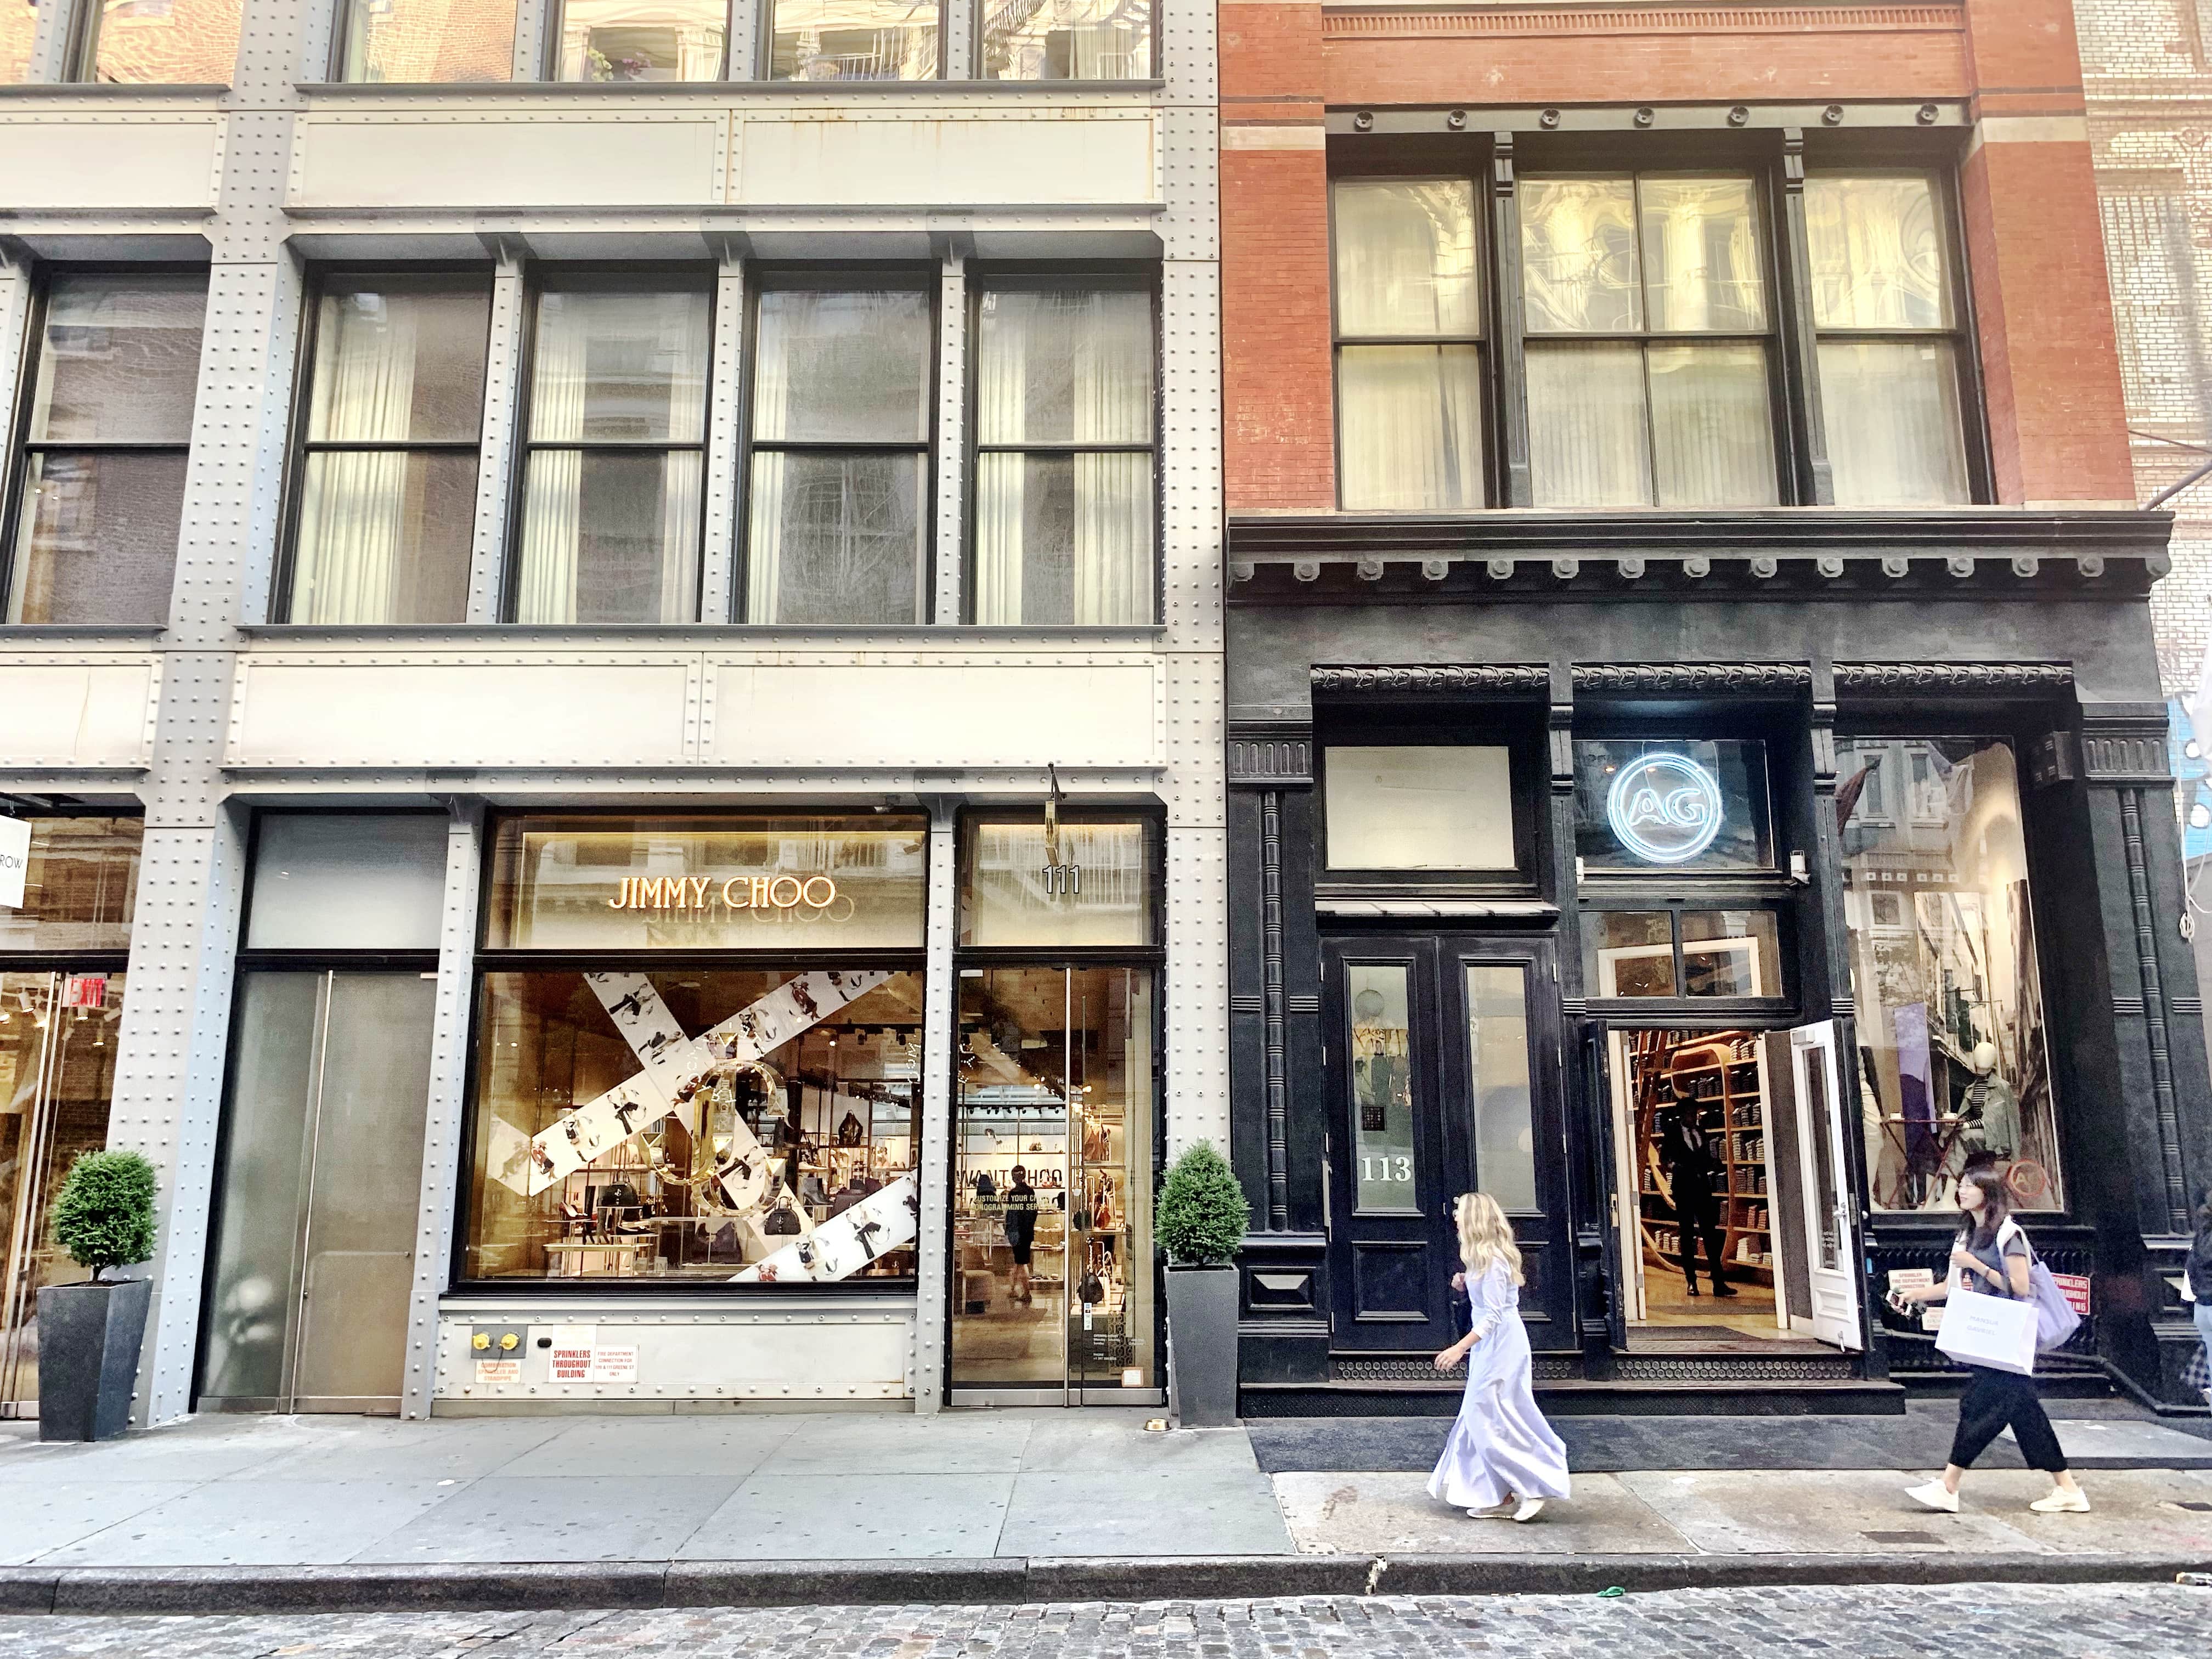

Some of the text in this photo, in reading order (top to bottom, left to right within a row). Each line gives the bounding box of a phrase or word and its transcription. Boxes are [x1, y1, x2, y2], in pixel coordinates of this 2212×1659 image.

[1627, 788, 1707, 827] AG
[1043, 864, 1080, 894] 111
[607, 876, 837, 909] JIMMY CHOO
[1361, 1155, 1412, 1182] 113
[1028, 1169, 1063, 1187] HOO
[2053, 1277, 2088, 1288] PRINKLERS
[554, 1350, 591, 1358] SPRINKLERS
[552, 1359, 591, 1368] THROUGHOUT
[557, 1369, 585, 1378] BUILDING
